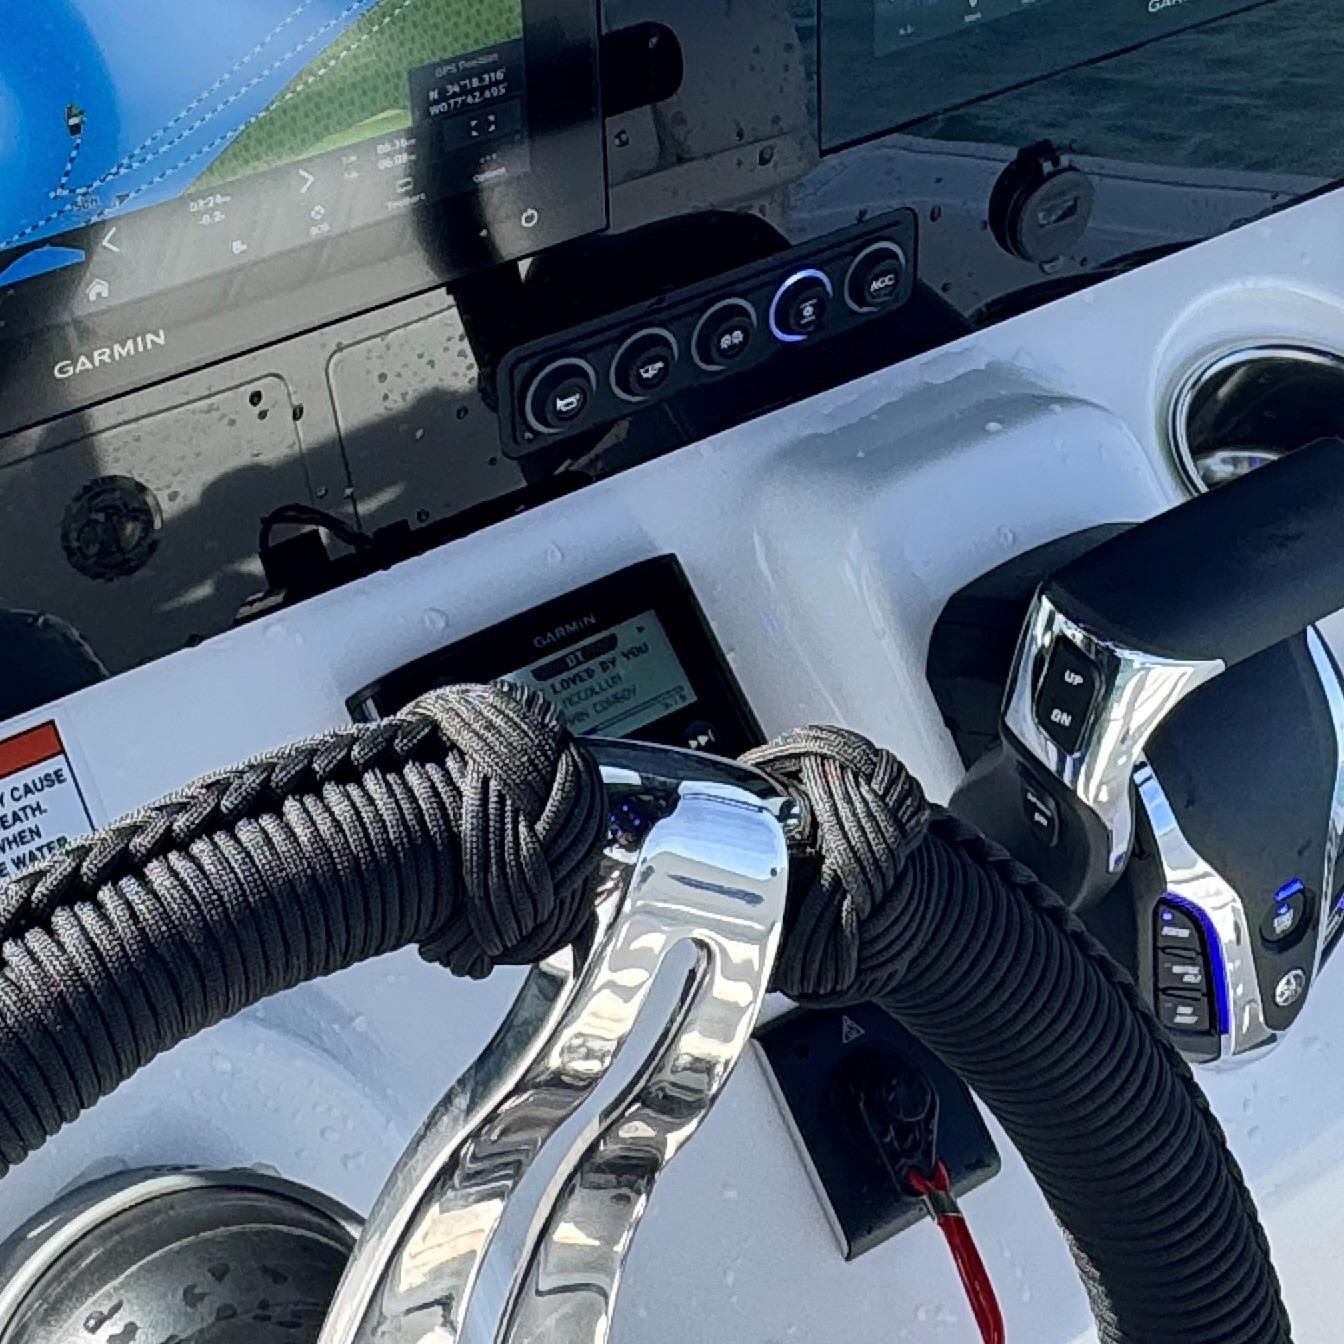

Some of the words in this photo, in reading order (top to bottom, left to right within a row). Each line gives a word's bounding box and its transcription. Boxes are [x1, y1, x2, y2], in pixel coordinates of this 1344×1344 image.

[869, 273, 896, 293] ACC
[53, 328, 167, 380] GARMIN
[532, 612, 597, 649] GARMIN
[621, 641, 650, 661] YOU
[1063, 668, 1084, 686] UP
[1050, 708, 1072, 728] DN
[10, 767, 69, 802] CAUSE
